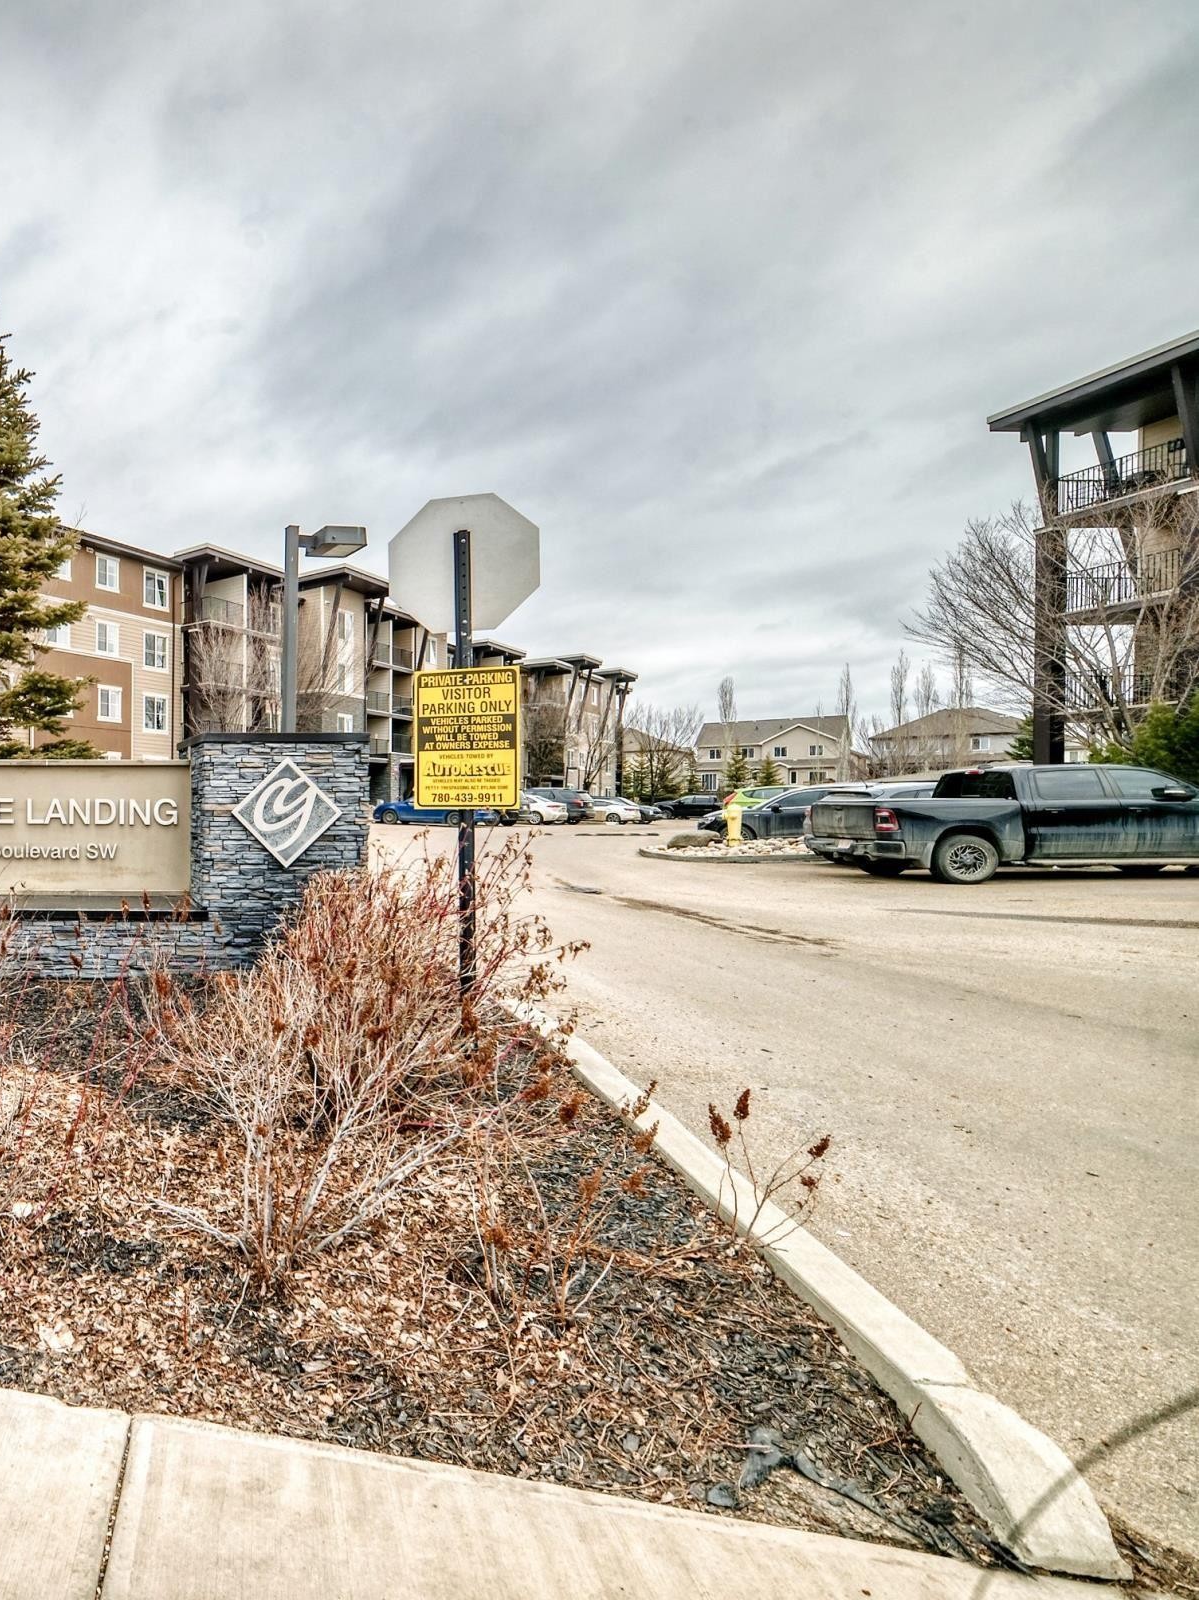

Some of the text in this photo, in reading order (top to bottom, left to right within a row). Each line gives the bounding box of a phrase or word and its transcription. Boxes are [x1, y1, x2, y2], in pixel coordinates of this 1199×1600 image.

[421, 672, 513, 687] PRIVATE PARKING
[442, 687, 491, 700] VISITOR
[422, 700, 512, 715] PARKING ONLY
[430, 715, 503, 726] VEHICLES PARKED
[422, 723, 512, 734] WITHOUT PERMISSION
[435, 732, 499, 741] WILL BE TOWED
[424, 740, 510, 750] AT OWNERS EXPENSE
[432, 793, 503, 803] 780-439-9911
[26, 798, 179, 826] LANDING
[86, 843, 117, 860] SW
